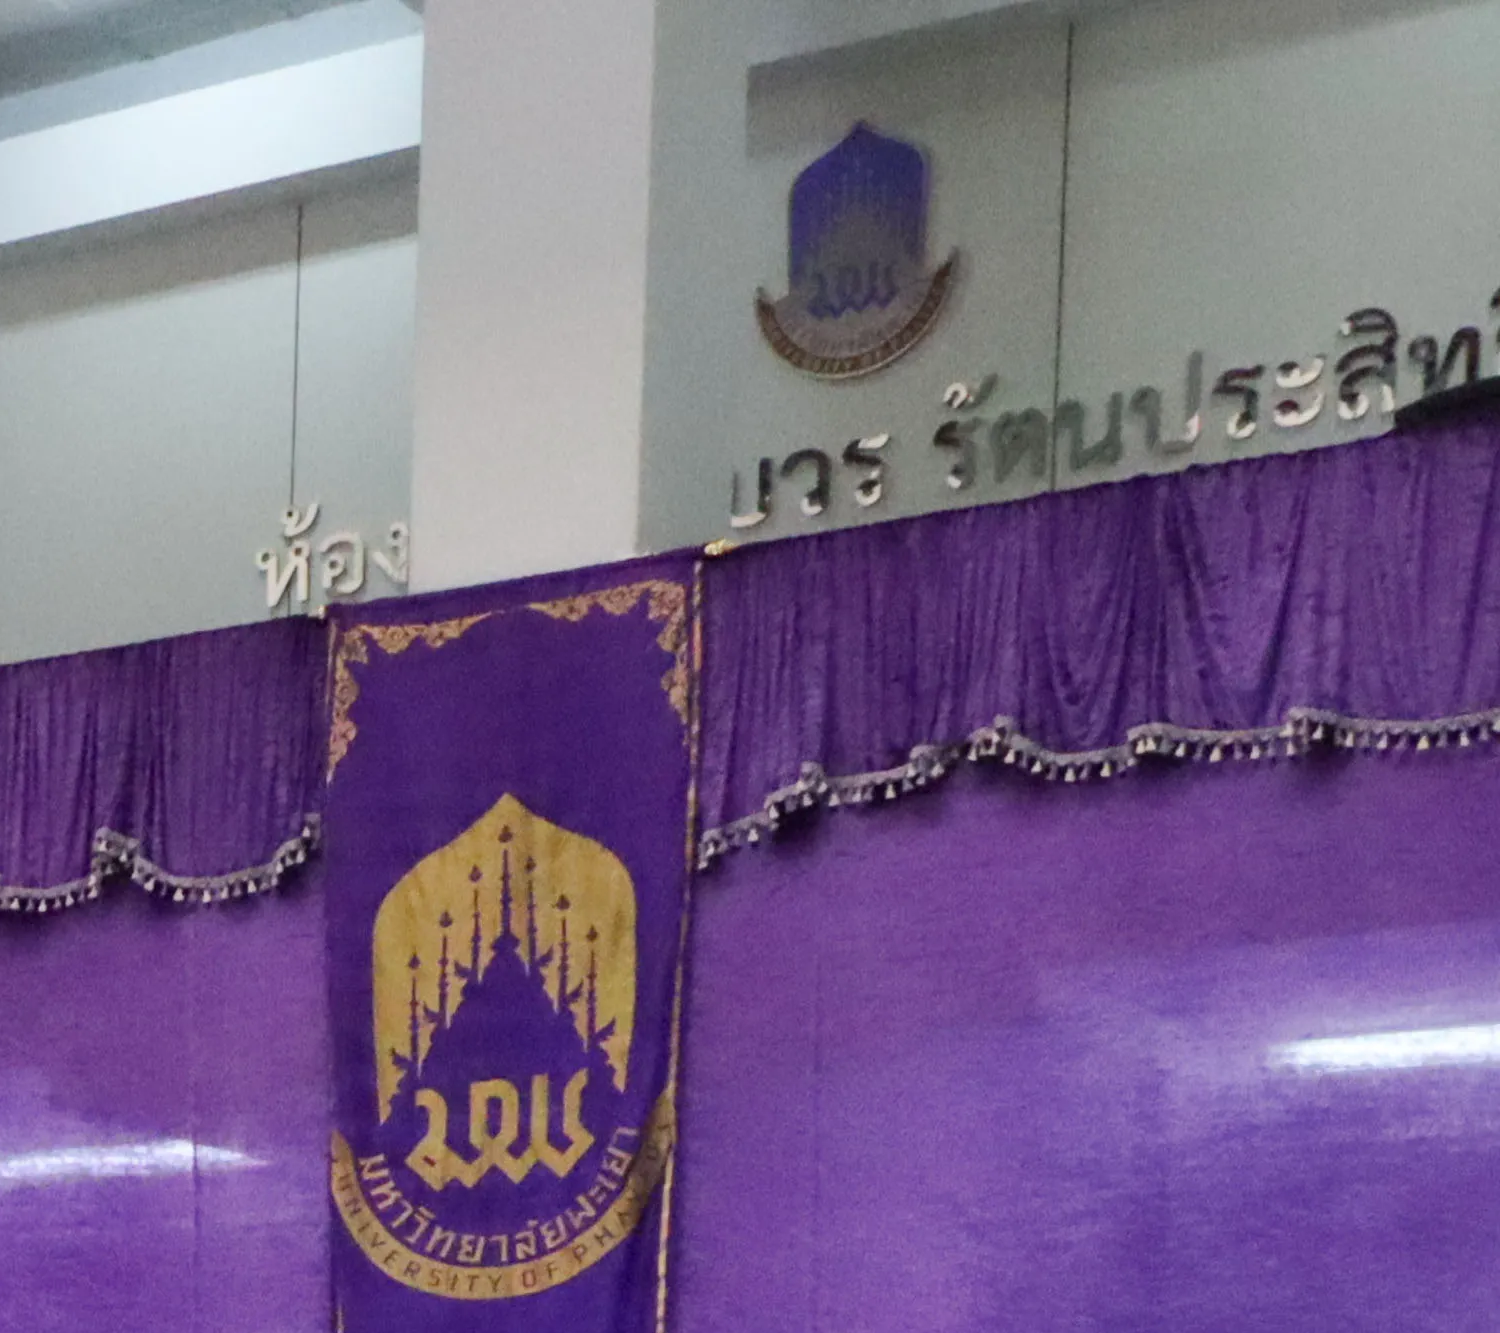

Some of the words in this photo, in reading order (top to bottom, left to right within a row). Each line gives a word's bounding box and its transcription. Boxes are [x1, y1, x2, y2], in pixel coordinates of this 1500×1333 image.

[255, 503, 408, 608] ห้อง
[932, 290, 1500, 489] รัตนประสิท
[337, 1172, 504, 1294] UNIVERSITY
[520, 1263, 560, 1290] OF
[358, 1126, 639, 1264] มหาวิทยาลัยพะเยา
